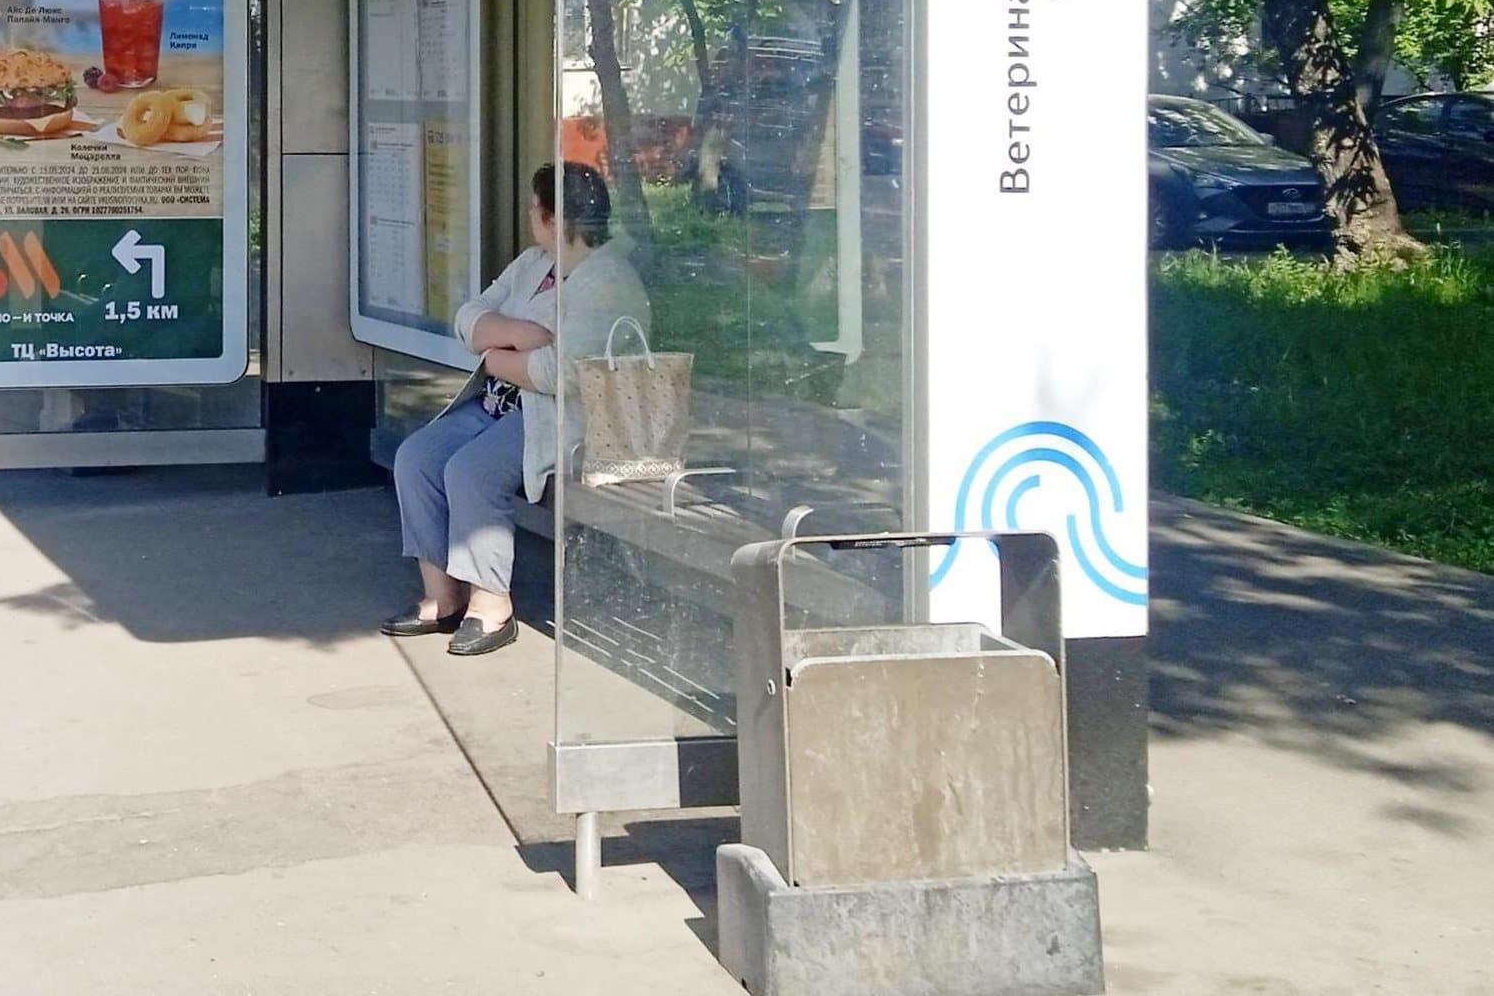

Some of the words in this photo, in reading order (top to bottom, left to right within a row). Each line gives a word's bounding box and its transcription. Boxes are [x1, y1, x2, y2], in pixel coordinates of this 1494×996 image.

[170, 32, 209, 41] Лимонад
[23, 313, 32, 323] И
[34, 312, 75, 323] ТОЧКА
[105, 301, 141, 324] 1,5
[147, 305, 178, 320] км
[11, 343, 35, 360] ТЦ
[39, 343, 122, 358] «Высота»
